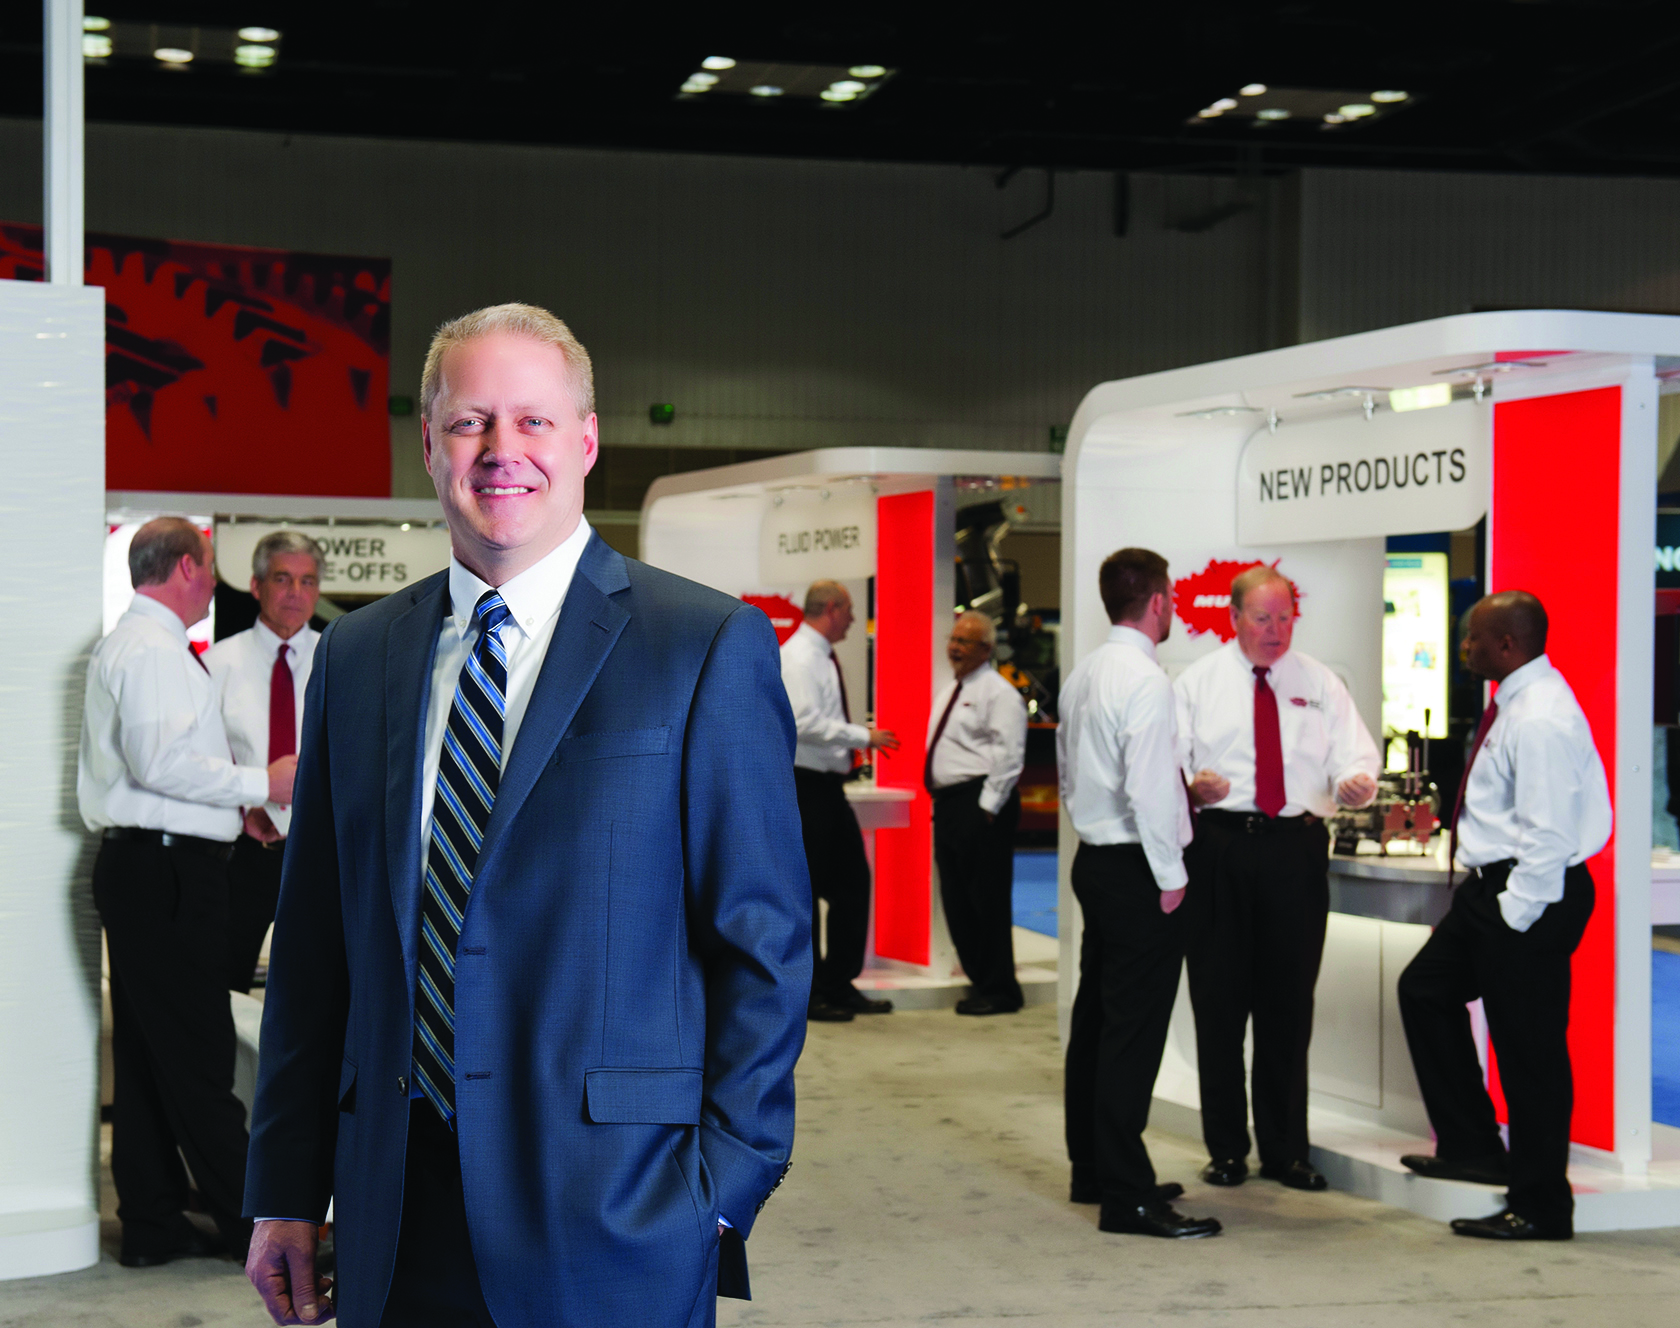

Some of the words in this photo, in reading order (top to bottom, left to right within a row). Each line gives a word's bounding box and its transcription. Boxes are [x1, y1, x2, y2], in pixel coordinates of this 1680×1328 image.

[1260, 466, 1312, 501] NEW
[1321, 448, 1466, 495] PRODUCTS
[317, 537, 385, 557] OWER
[322, 561, 408, 582] E-OFFS
